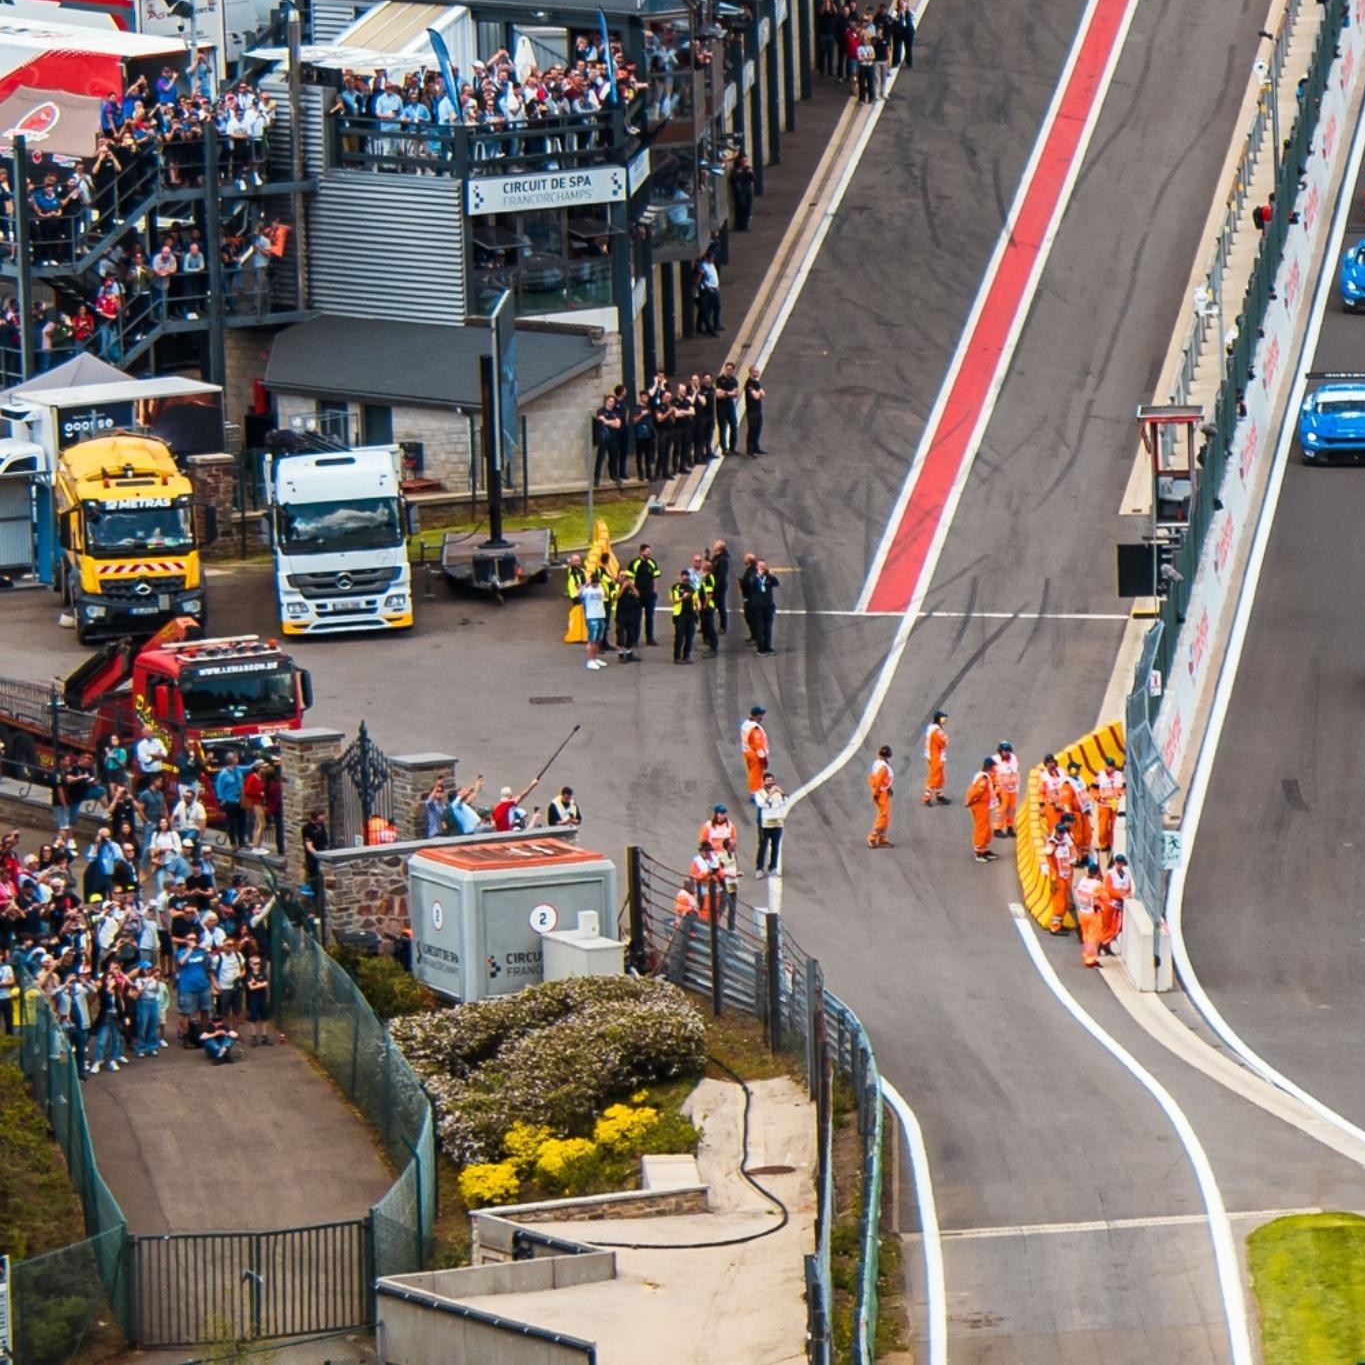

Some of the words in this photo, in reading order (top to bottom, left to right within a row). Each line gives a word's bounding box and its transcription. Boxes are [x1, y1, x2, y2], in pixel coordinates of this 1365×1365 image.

[503, 179, 547, 194] CIRCUIT
[551, 177, 566, 190] DE
[569, 175, 592, 188] SPA
[503, 189, 593, 207] FRANCORCHAMPS
[118, 497, 171, 510] METRAS
[539, 912, 548, 926] 2
[506, 952, 542, 966] CIRCU
